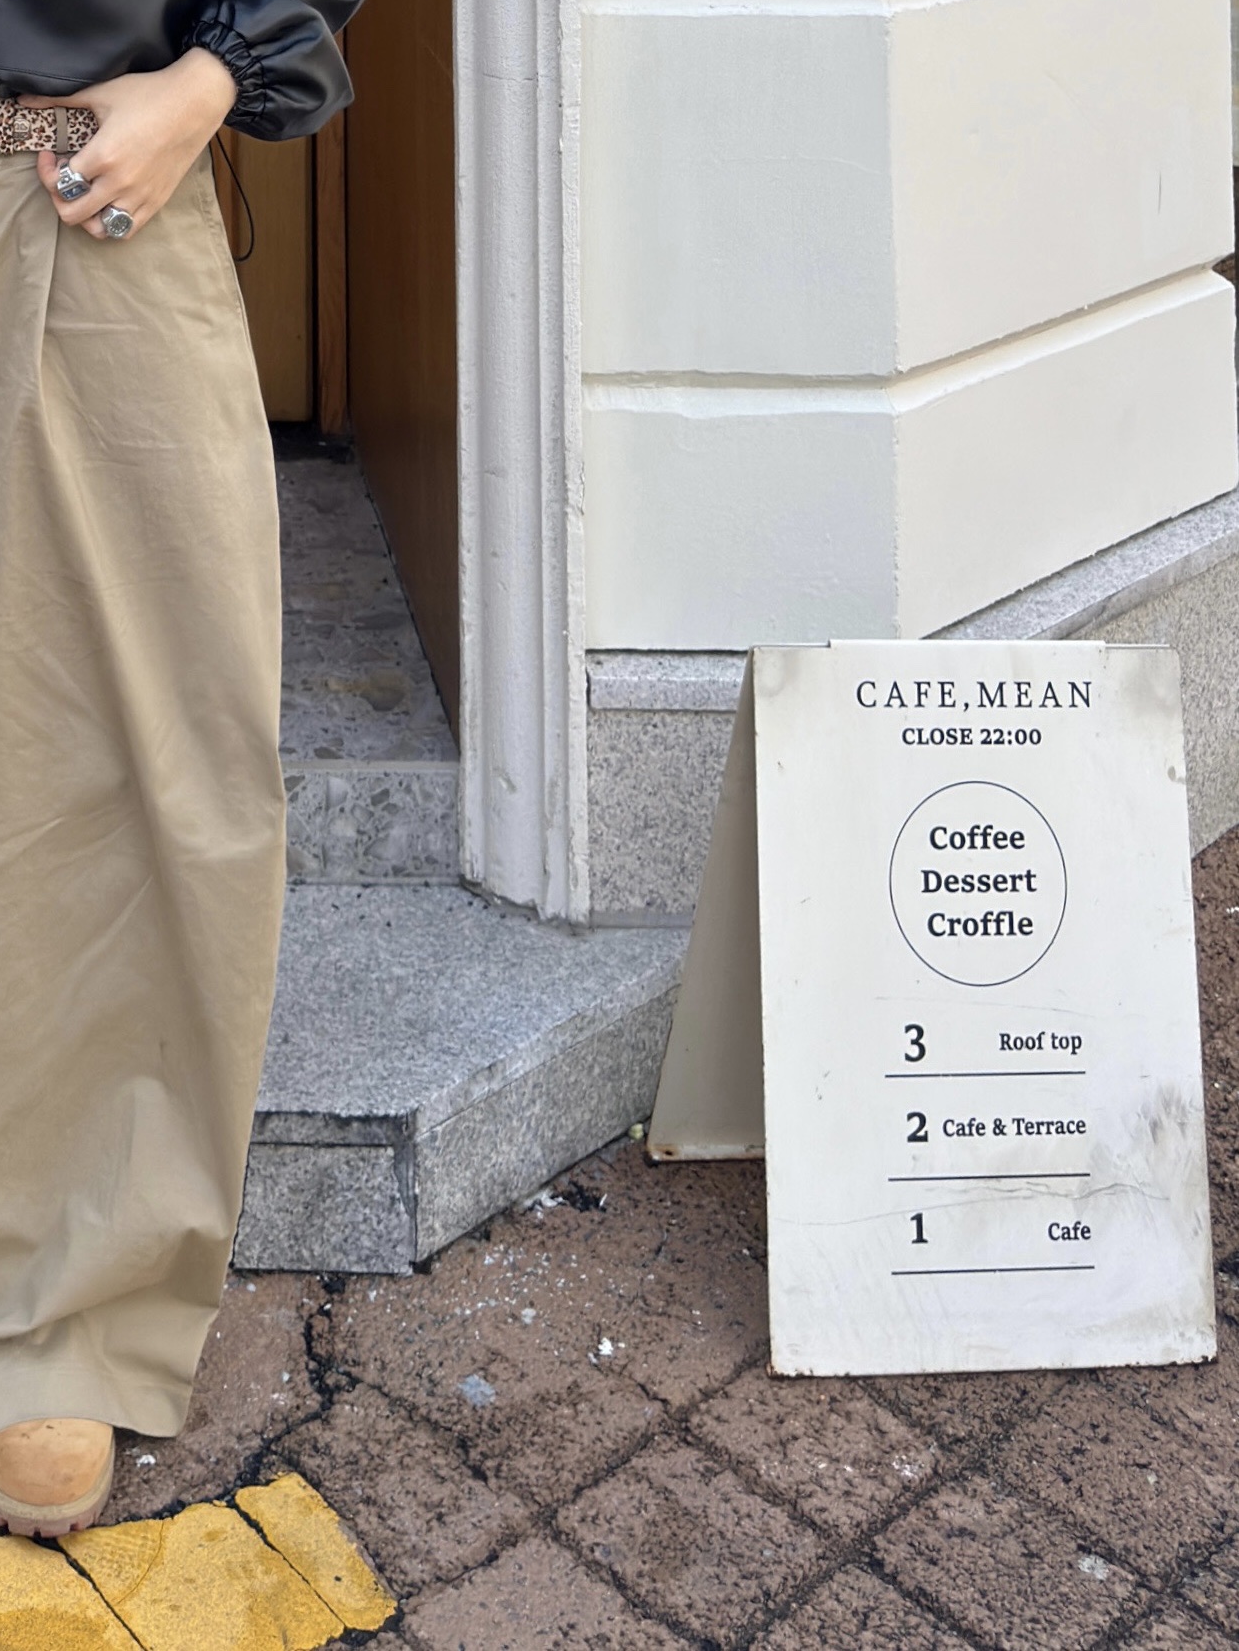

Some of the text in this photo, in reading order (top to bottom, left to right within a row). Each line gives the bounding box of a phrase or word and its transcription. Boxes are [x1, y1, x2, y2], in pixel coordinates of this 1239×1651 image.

[901, 727, 1042, 746] CLOSE 22:00
[929, 826, 1026, 851] Coffee
[921, 869, 1037, 894] Dessert
[927, 911, 1034, 938] Croffle
[904, 1024, 1082, 1063] 3 Roof top
[906, 1111, 1087, 1143] 2 Cafe & Terrace
[910, 1213, 1091, 1244] 1 Cafe
